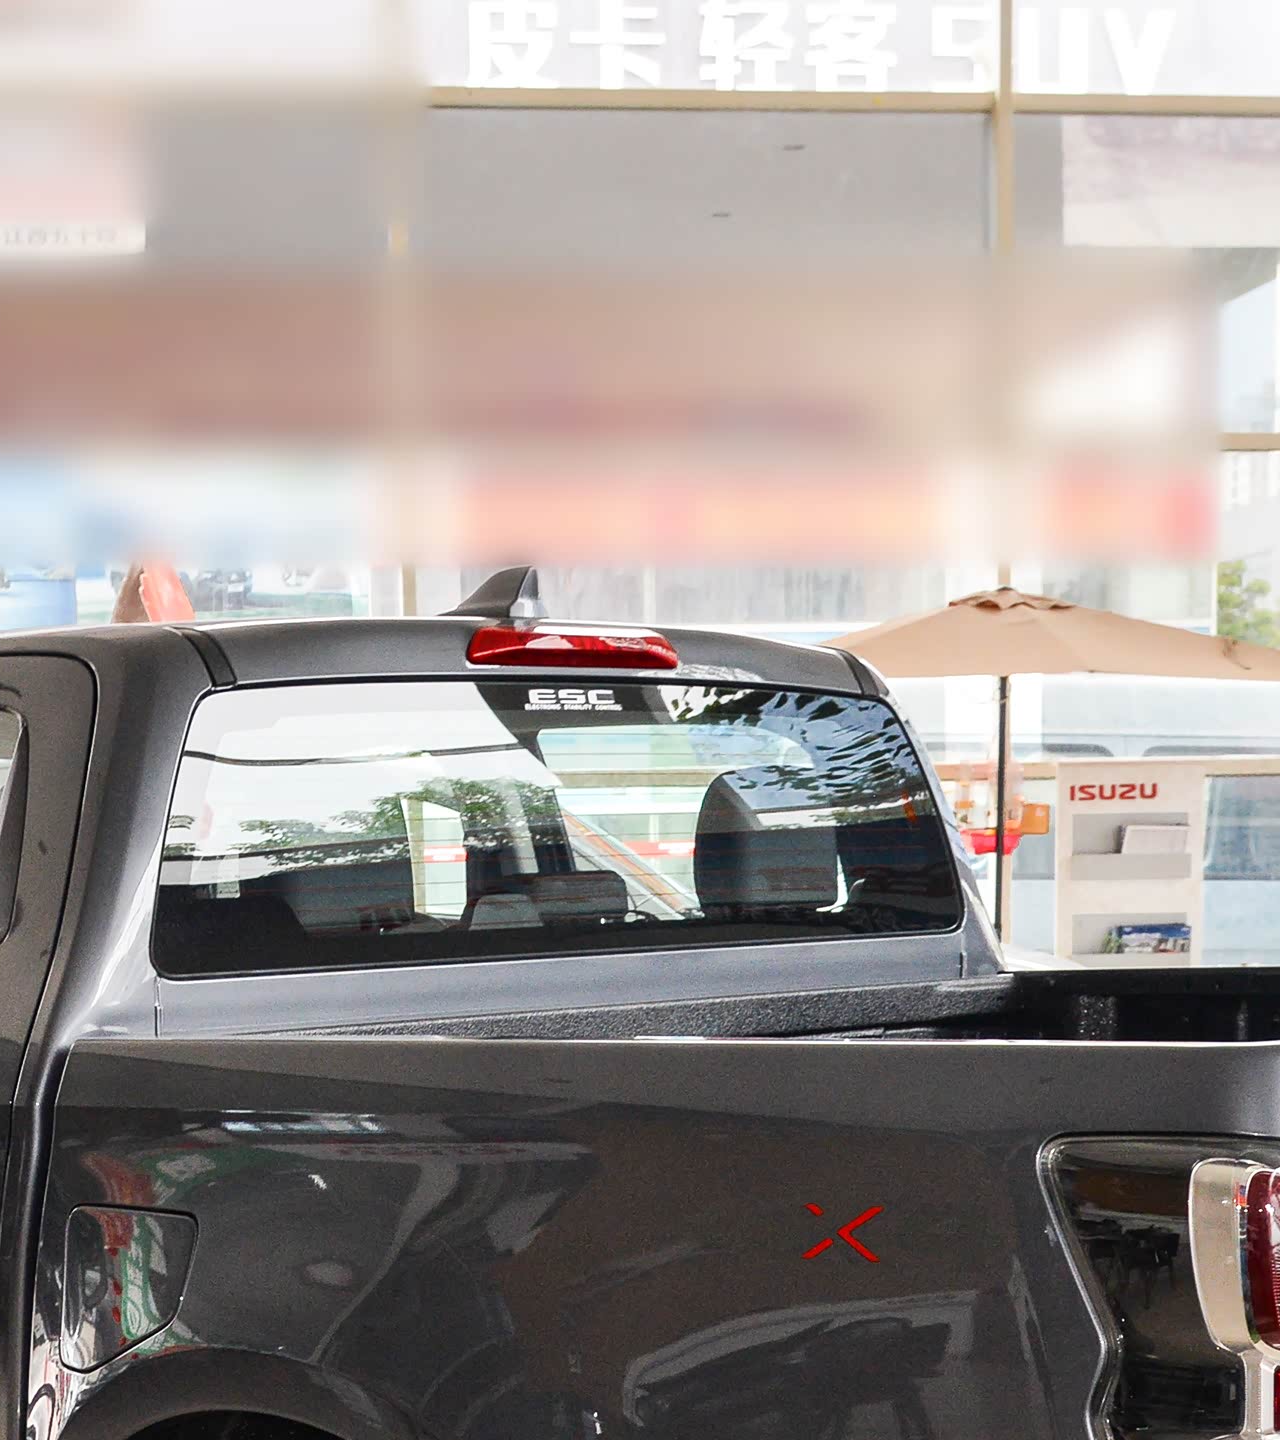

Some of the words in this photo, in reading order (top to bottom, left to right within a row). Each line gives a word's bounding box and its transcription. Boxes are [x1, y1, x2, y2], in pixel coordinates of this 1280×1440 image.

[465, 0, 666, 90] 皮卡
[698, 0, 897, 91] 轻客
[528, 688, 616, 704] ESC
[1069, 782, 1158, 801] ISUZU
